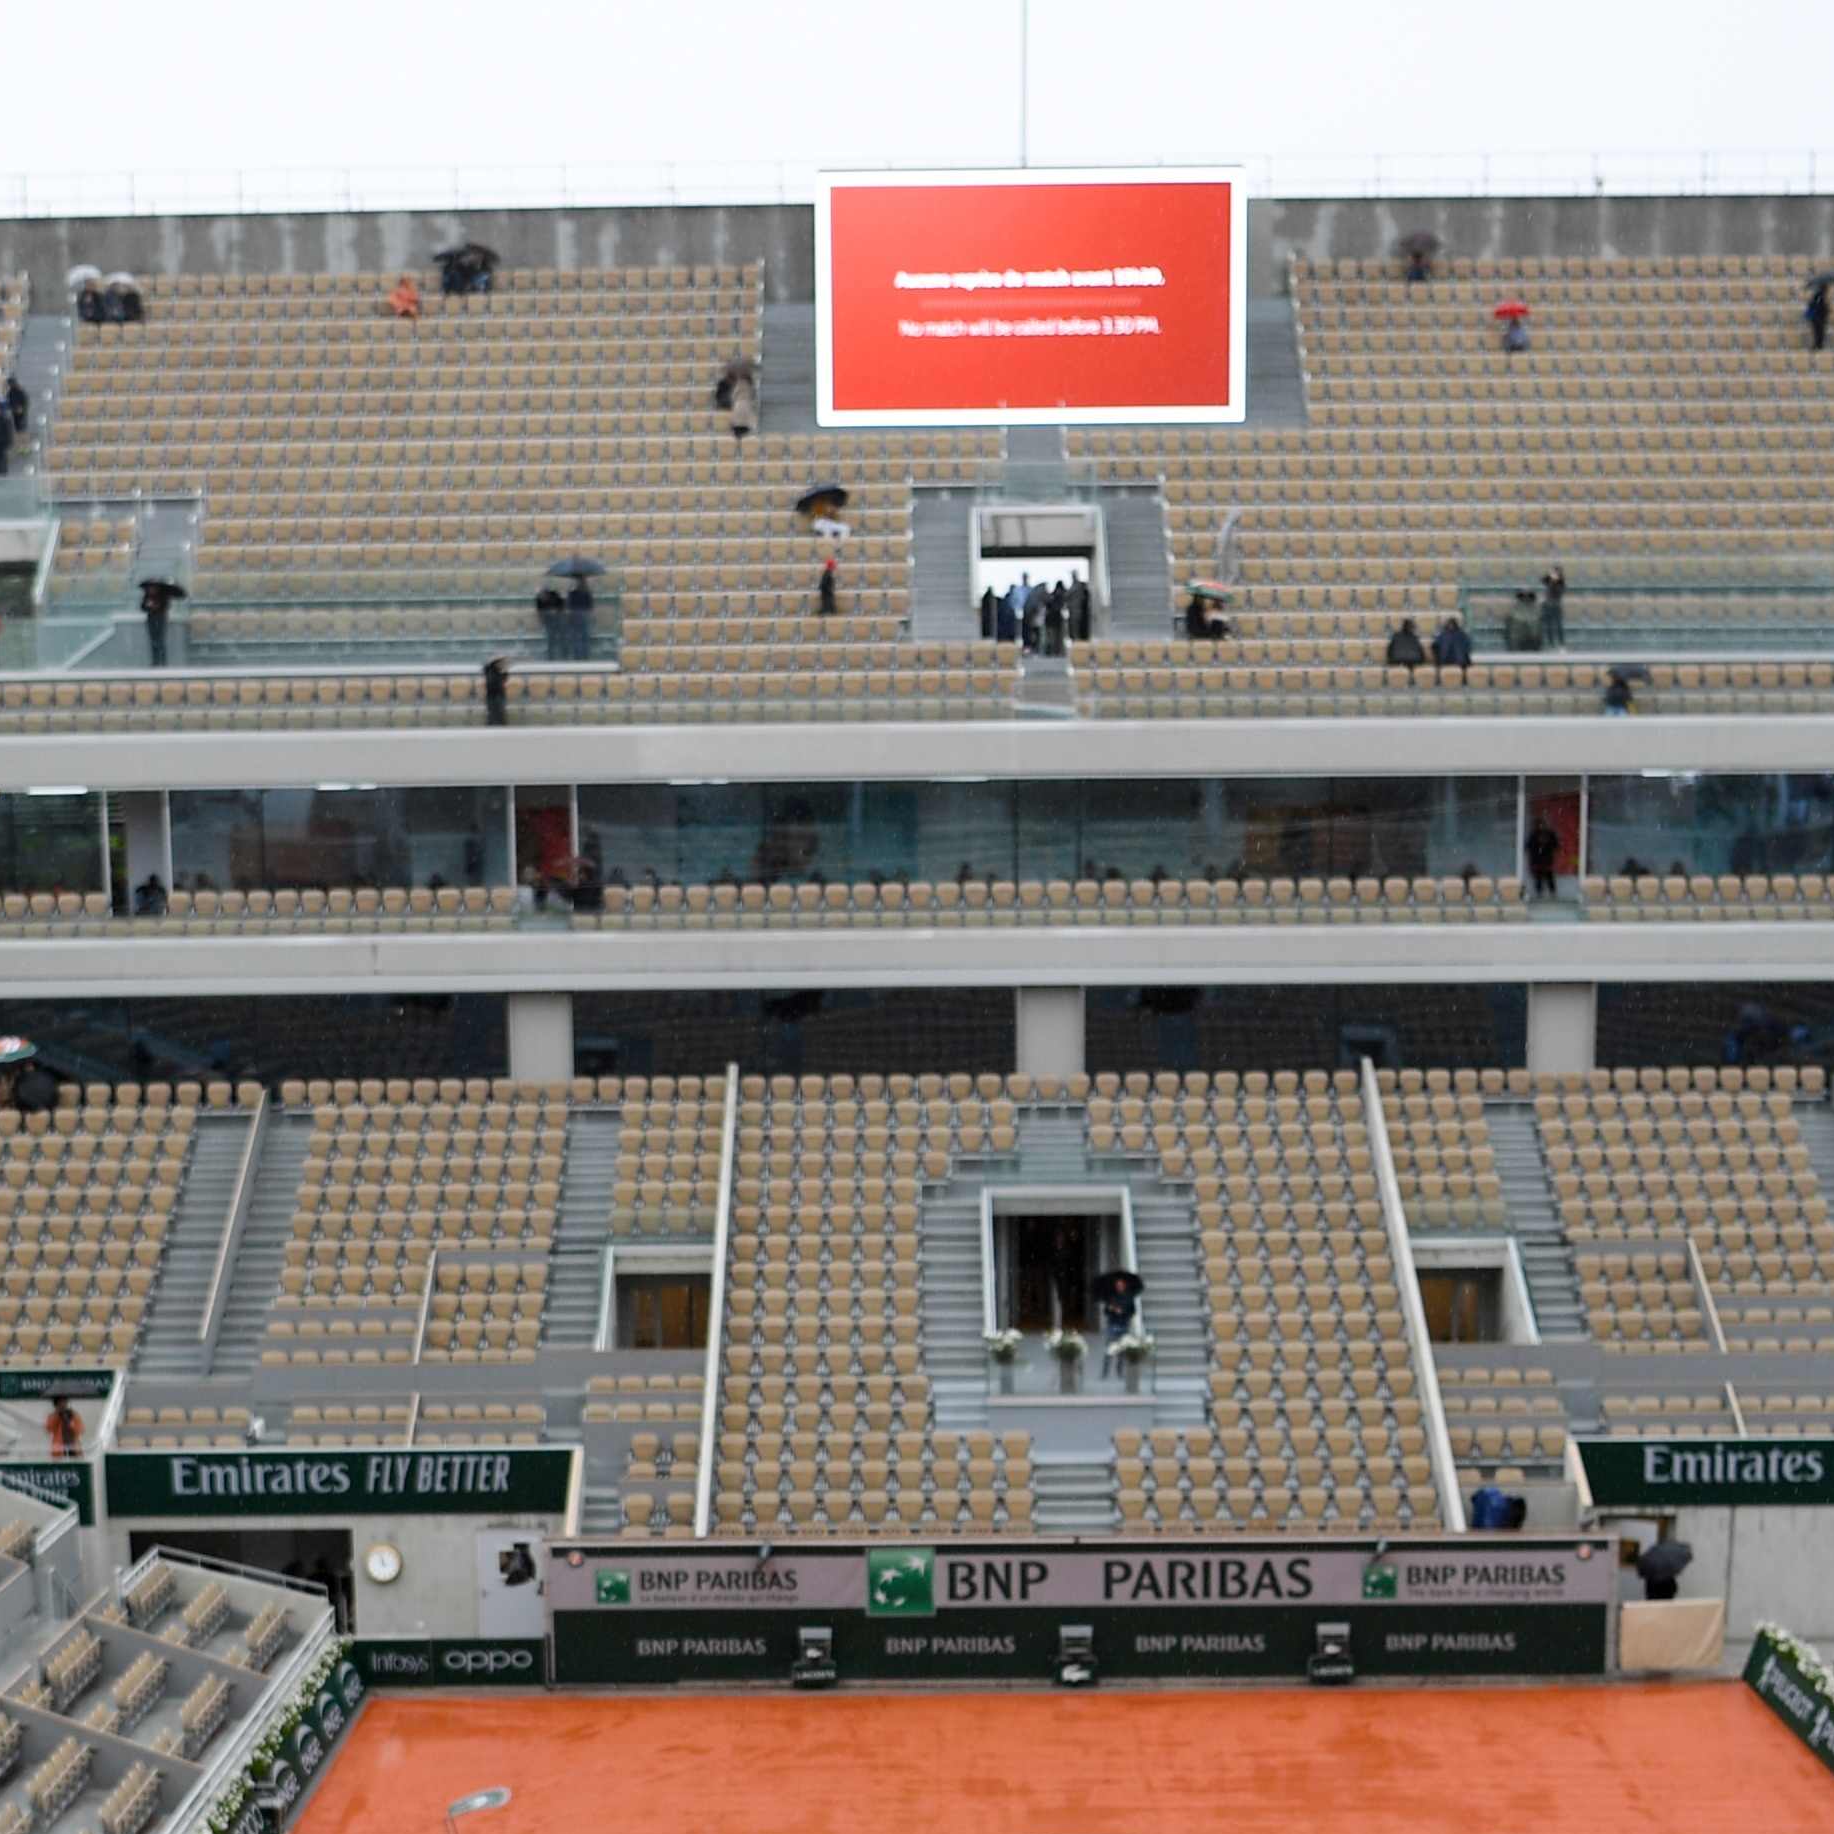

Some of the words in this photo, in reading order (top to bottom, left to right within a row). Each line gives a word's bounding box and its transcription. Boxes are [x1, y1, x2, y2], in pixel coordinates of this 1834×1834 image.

[1643, 1443, 1824, 1484] Emirates
[170, 1456, 351, 1496] Emirates
[367, 1455, 412, 1493] FLY
[416, 1454, 511, 1493] BETTER
[640, 1570, 689, 1591] BNP
[697, 1570, 798, 1591] PARIBAS
[948, 1561, 1049, 1601] BNP
[1102, 1558, 1313, 1600] PARIBAS
[1406, 1564, 1456, 1586] BNP
[1464, 1564, 1565, 1585] PARIBAS
[637, 1639, 679, 1656] BNP
[682, 1638, 766, 1655] PARIBAS
[886, 1637, 927, 1655] BNP
[932, 1635, 1016, 1655] PARIBAS
[1136, 1635, 1177, 1653] BNP
[1182, 1635, 1266, 1653] PARIBAS
[1385, 1633, 1428, 1650] BNP
[1431, 1632, 1516, 1650] PARIBAS
[445, 1650, 533, 1673] oppo
